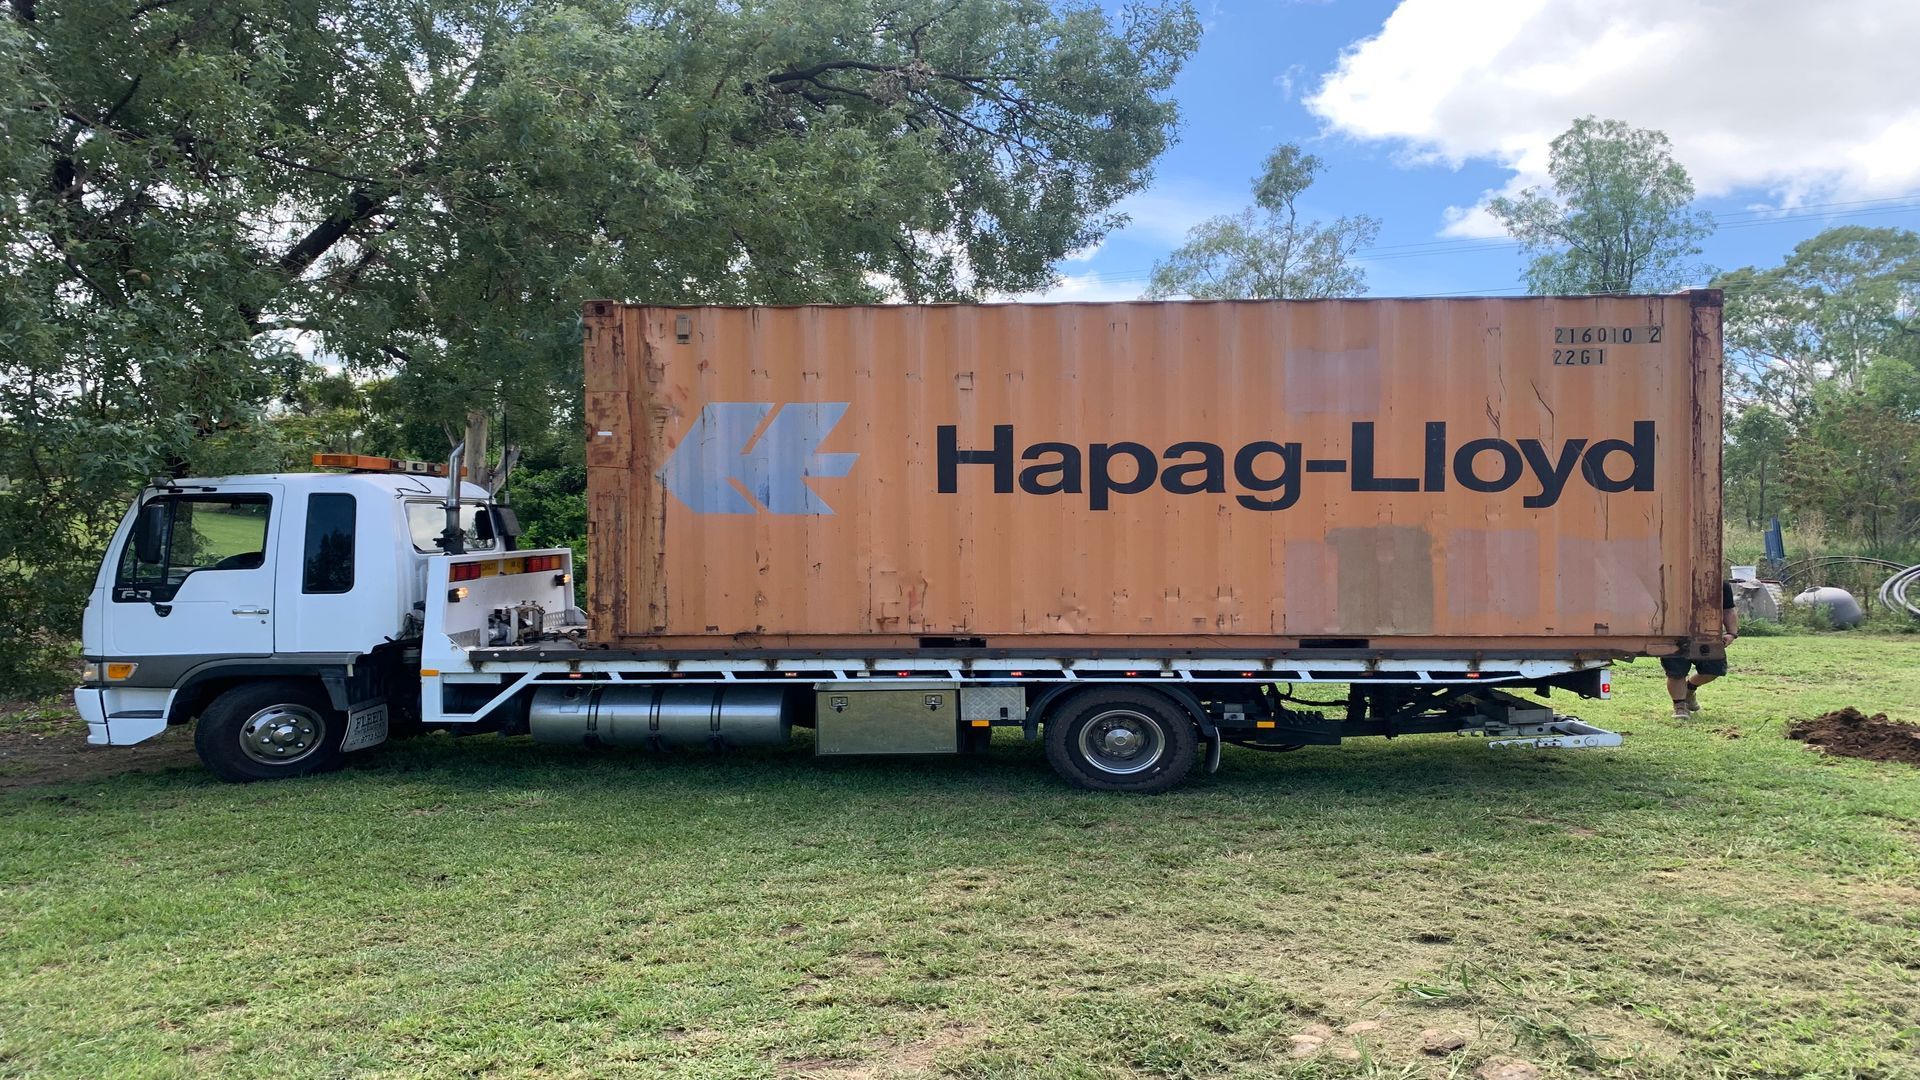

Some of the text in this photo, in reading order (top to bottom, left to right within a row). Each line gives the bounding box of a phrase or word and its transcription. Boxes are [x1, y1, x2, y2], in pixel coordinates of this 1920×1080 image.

[1555, 327, 1659, 343] 216010 2
[1554, 349, 1603, 365] 22G1
[937, 420, 1655, 511] Hapag-Lloyd
[356, 710, 383, 729] FLEET
